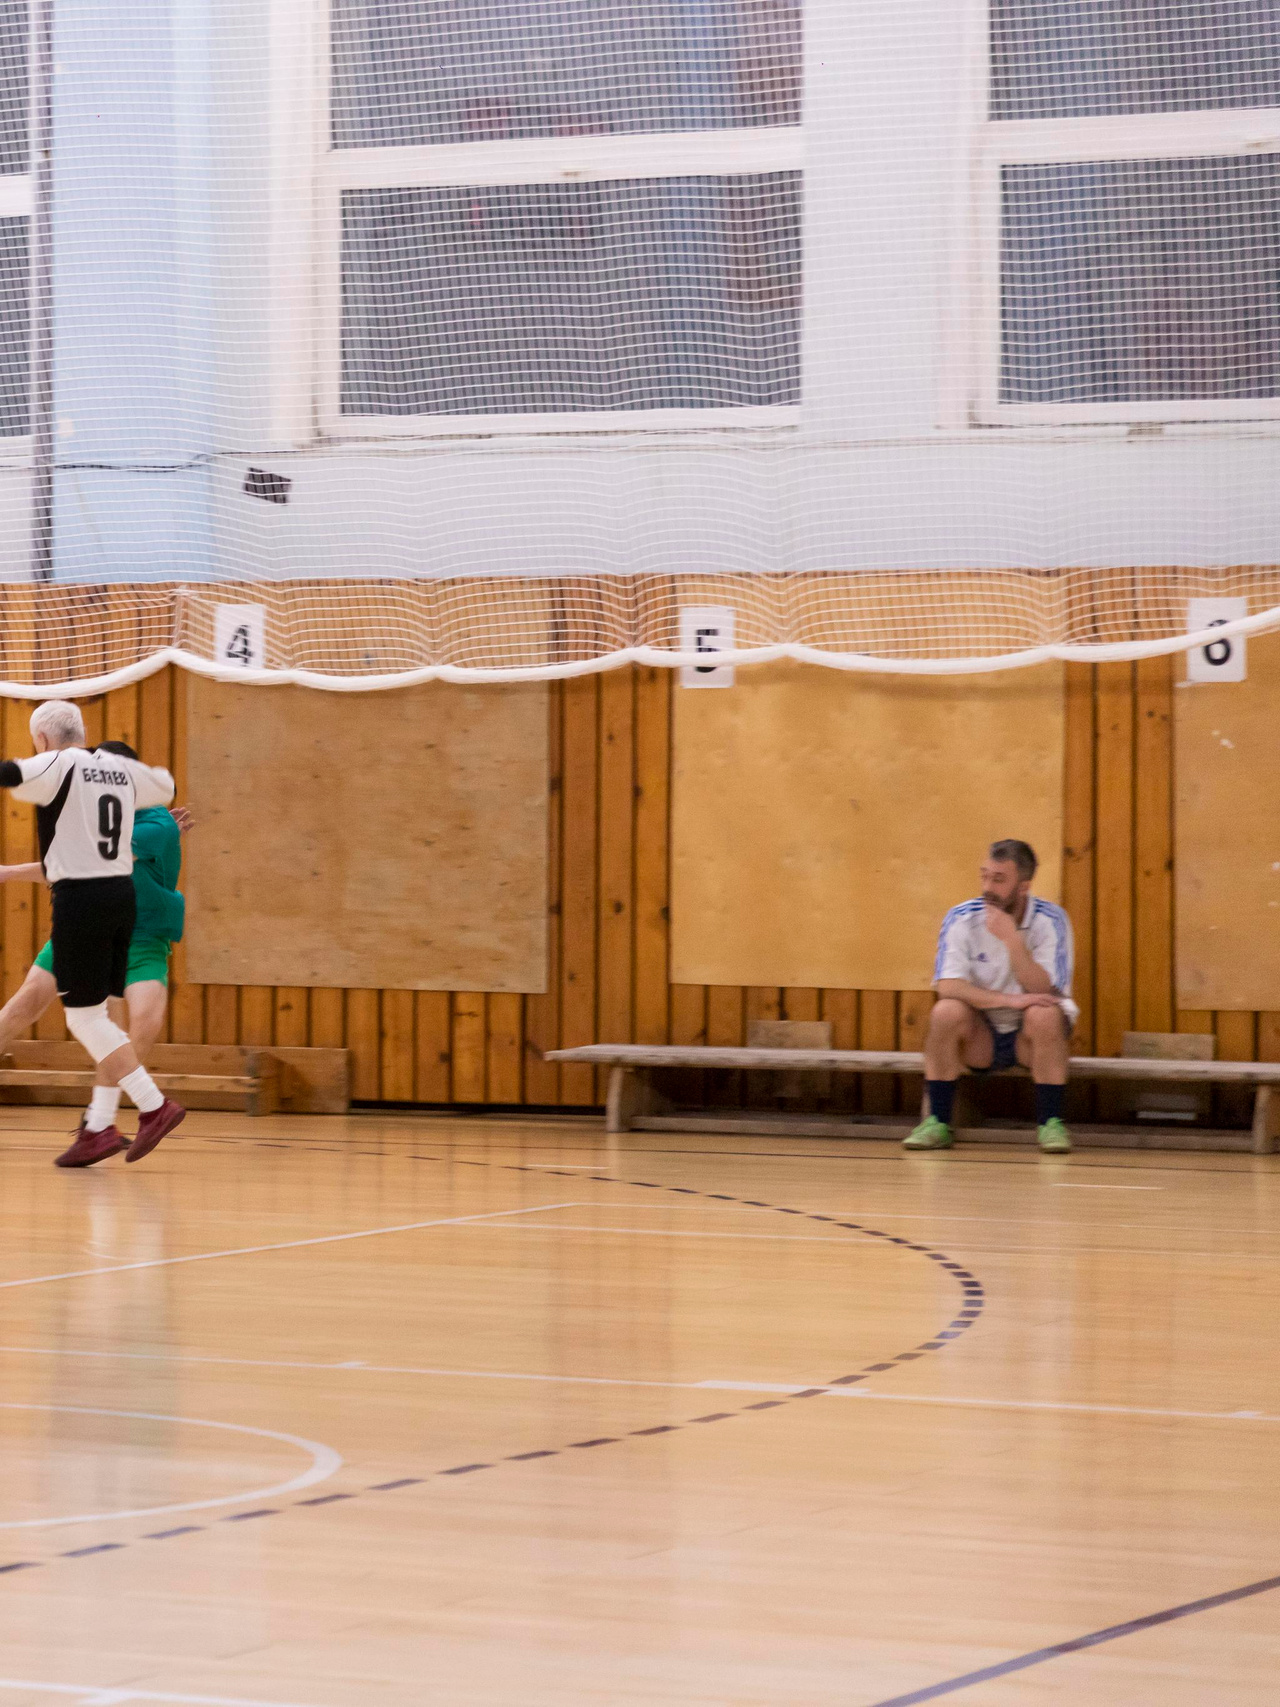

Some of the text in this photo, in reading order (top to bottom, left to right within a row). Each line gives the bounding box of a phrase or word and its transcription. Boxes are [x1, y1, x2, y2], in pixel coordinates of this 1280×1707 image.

[225, 624, 254, 667] 4
[694, 629, 721, 673] 5
[1203, 619, 1232, 666] 6
[97, 793, 123, 861] 9
